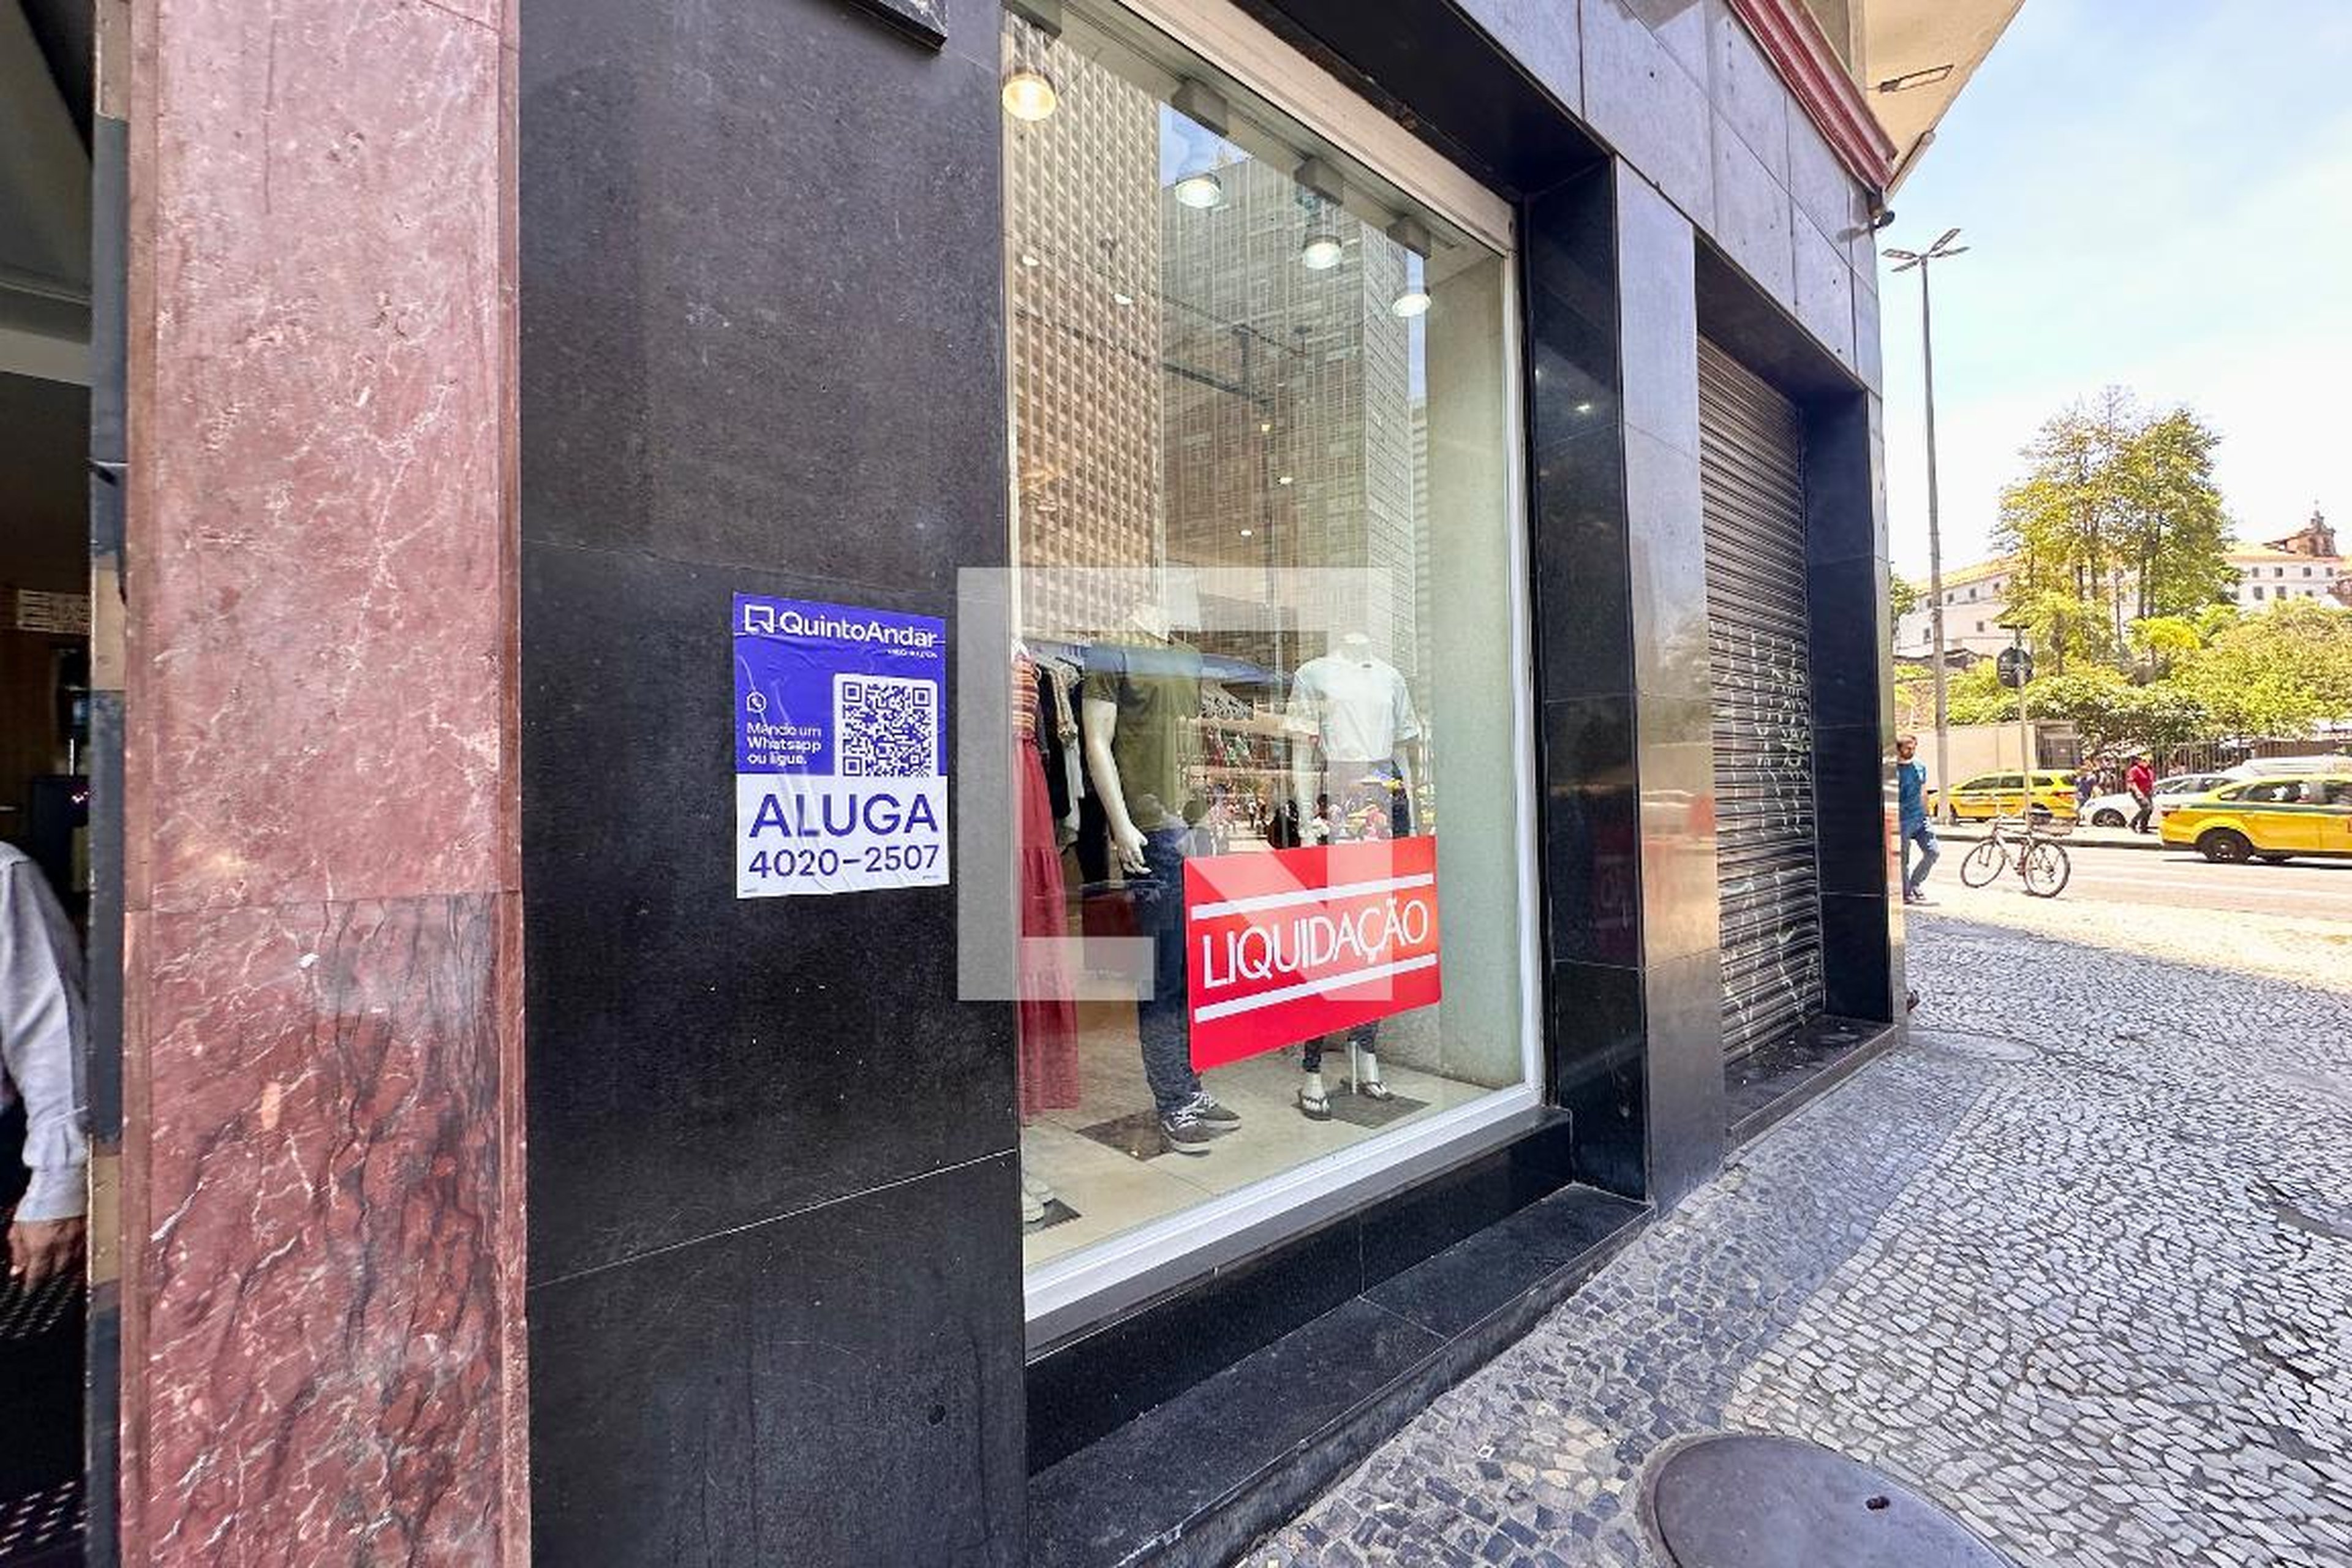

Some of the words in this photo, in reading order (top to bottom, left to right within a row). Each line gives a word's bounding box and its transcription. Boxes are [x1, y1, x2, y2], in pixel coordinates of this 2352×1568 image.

[779, 611, 938, 647] QuintoAndar
[799, 726, 821, 737] um
[747, 753, 766, 764] ou
[749, 794, 938, 838] ALUGA
[748, 845, 939, 878] 4020-2507
[1202, 898, 1428, 989] LIQUIDAÇÃO
